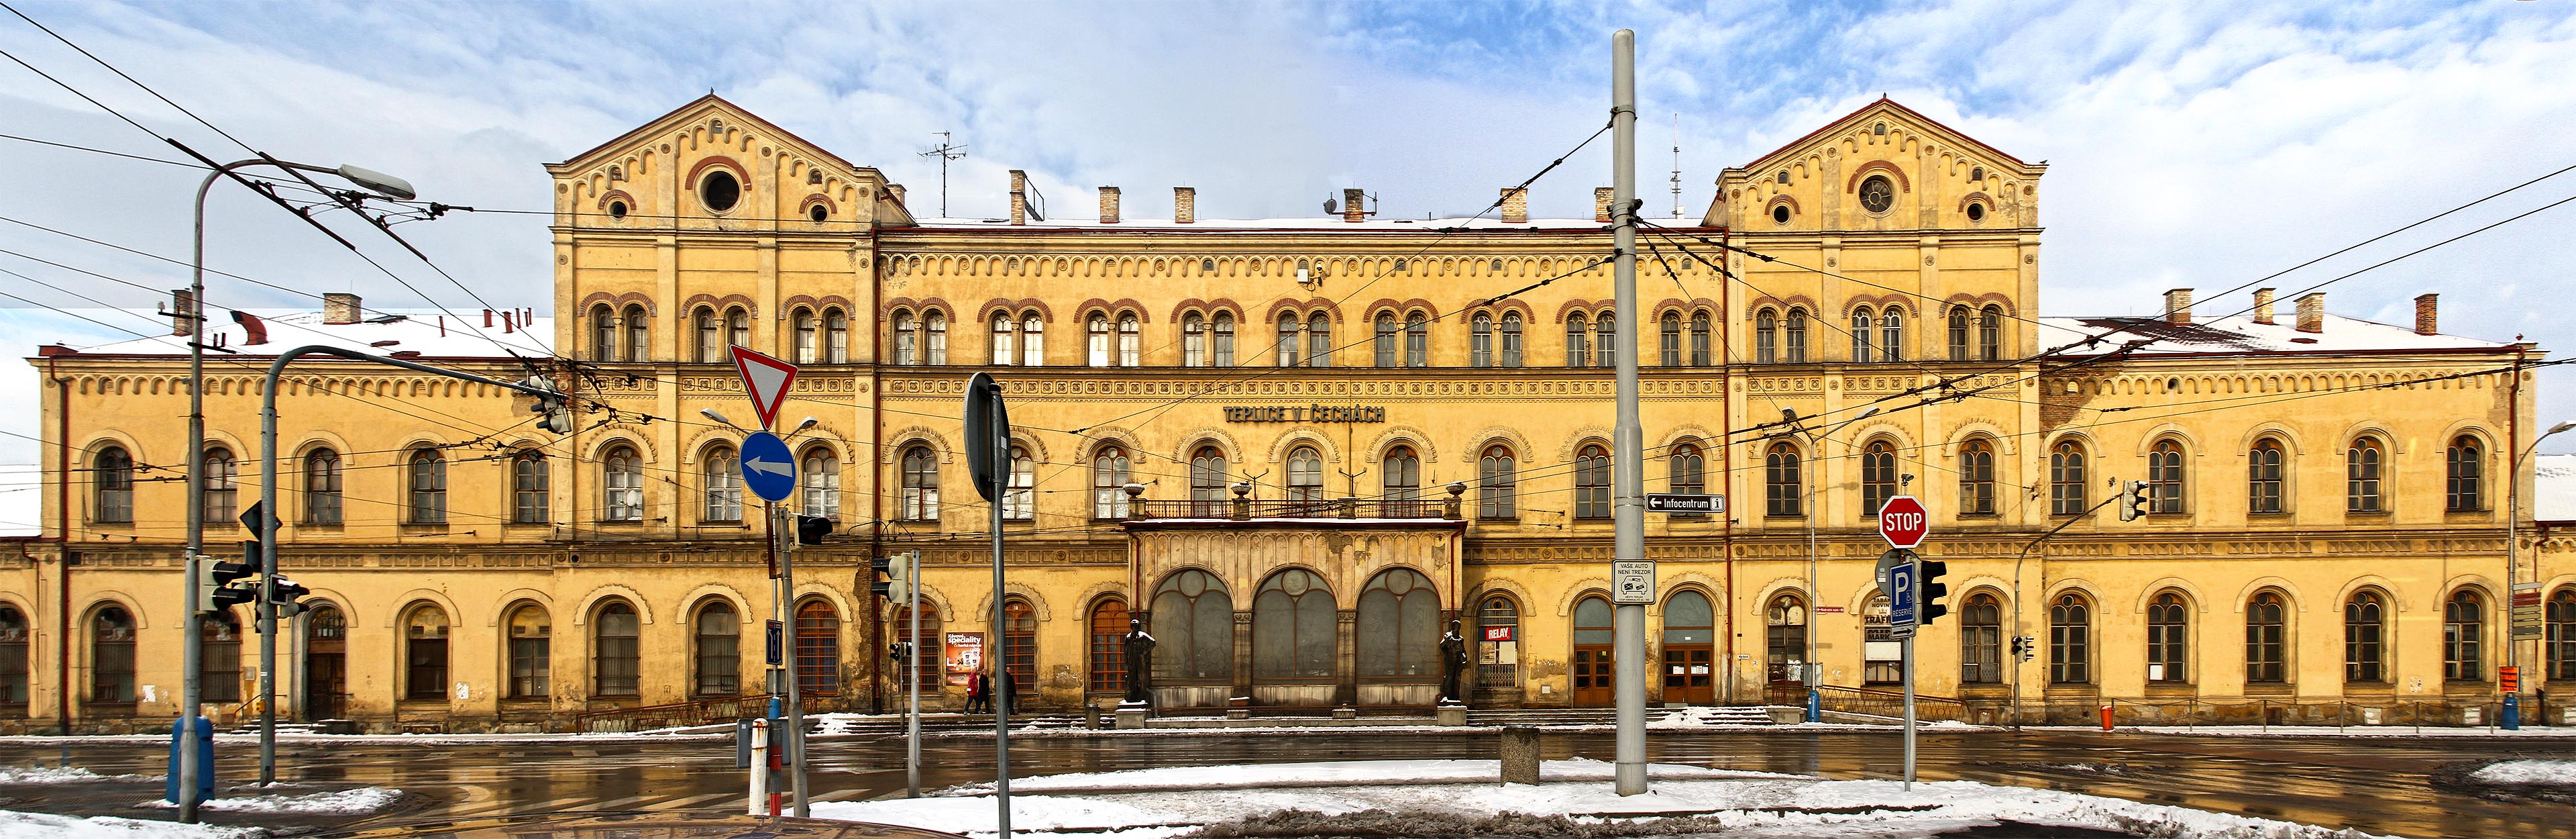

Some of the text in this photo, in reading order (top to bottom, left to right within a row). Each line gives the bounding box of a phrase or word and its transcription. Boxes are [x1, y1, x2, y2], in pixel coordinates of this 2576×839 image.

[1223, 403, 1385, 424] TEPLICE V ČECHÁCH
[1664, 498, 1709, 509] Infocentrum
[1886, 512, 1922, 532] STOP
[1895, 571, 1909, 605] P
[1865, 615, 1890, 624] TRAFI
[1489, 628, 1509, 639] RELAY
[948, 636, 981, 644] speciality
